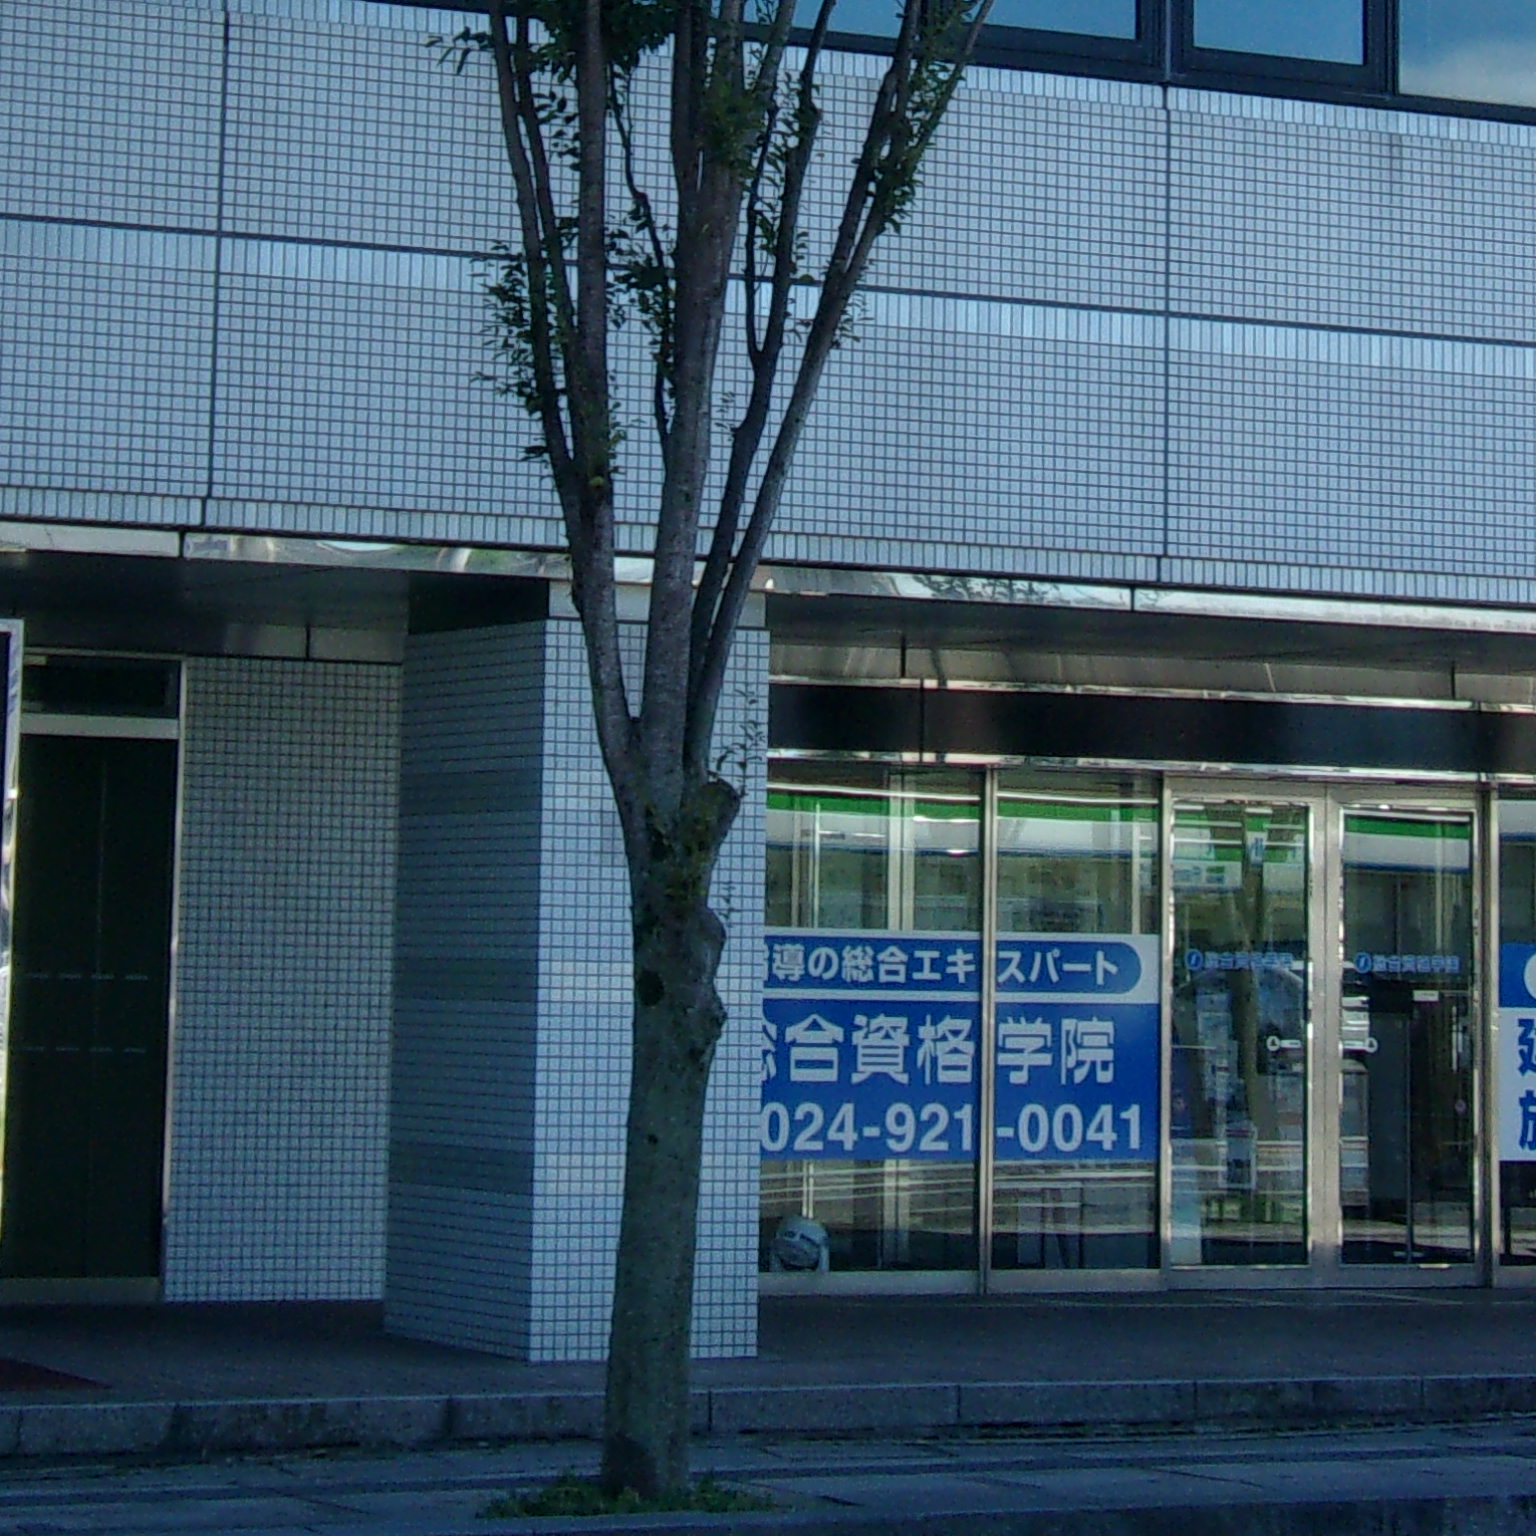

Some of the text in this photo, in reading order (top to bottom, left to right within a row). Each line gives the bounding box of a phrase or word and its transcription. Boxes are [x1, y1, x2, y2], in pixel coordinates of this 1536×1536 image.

[763, 943, 1118, 986] 導の総合エキスパート
[762, 1013, 1115, 1086] 合資格学院
